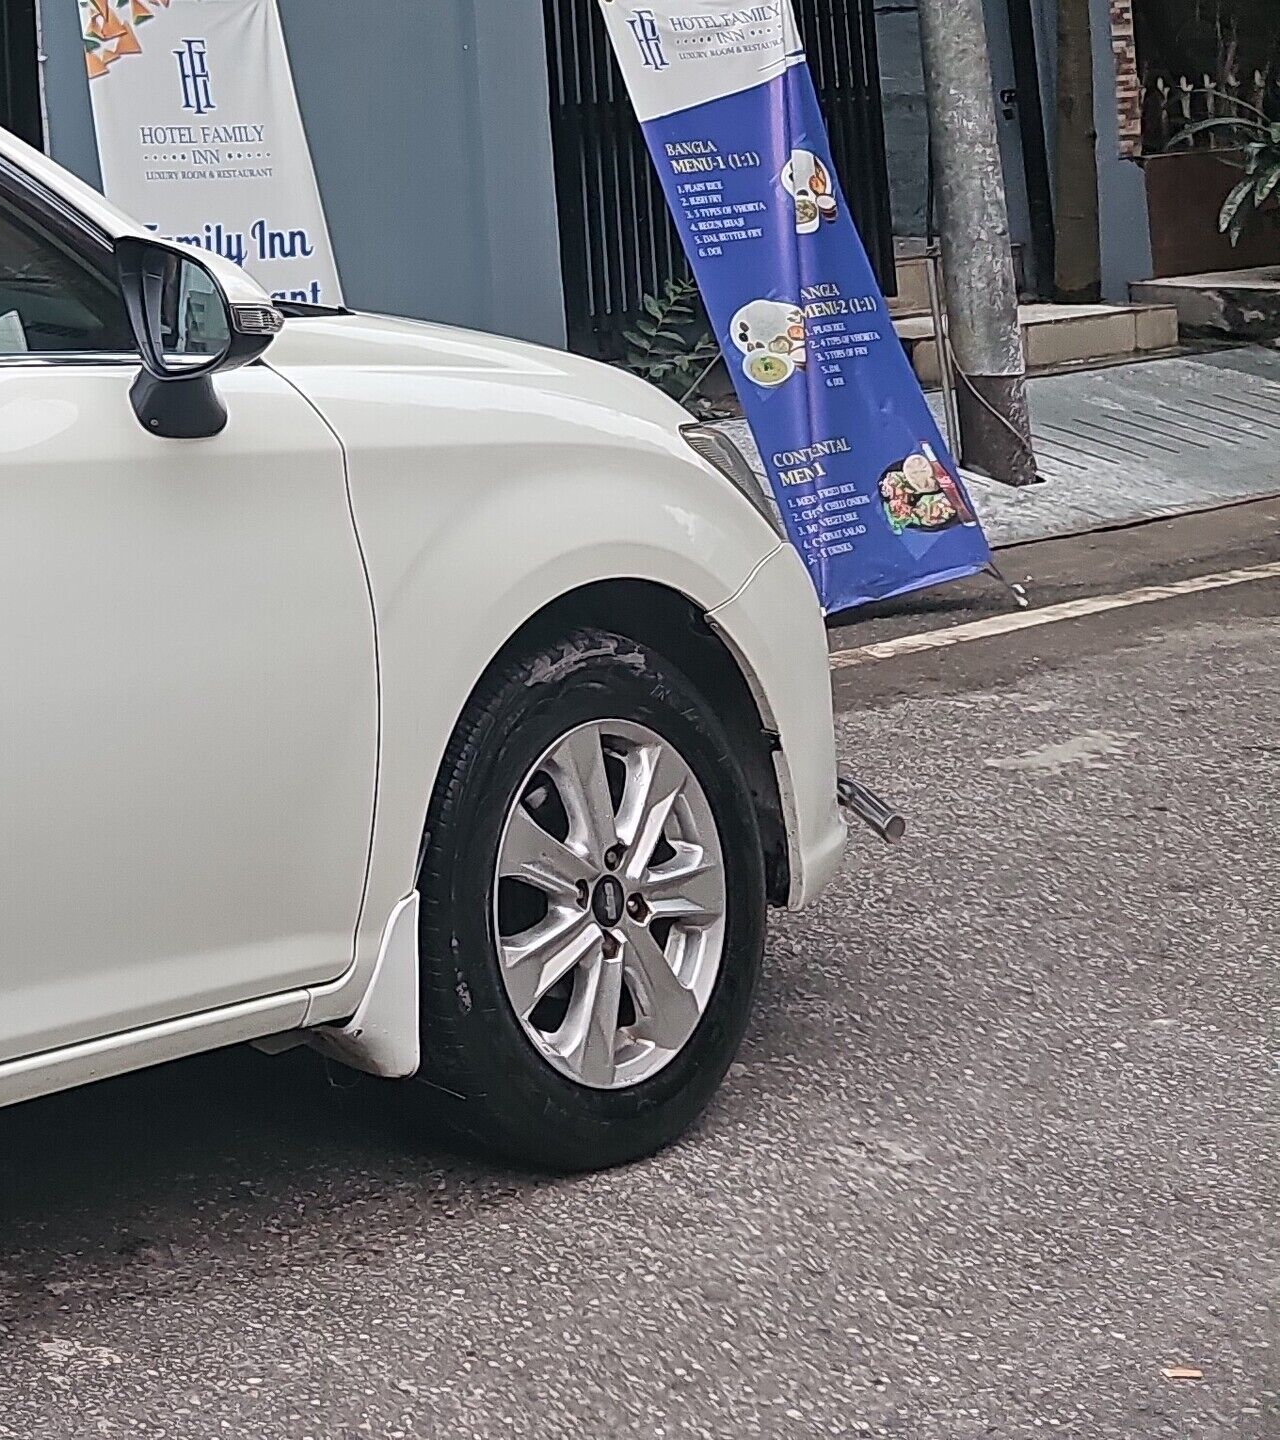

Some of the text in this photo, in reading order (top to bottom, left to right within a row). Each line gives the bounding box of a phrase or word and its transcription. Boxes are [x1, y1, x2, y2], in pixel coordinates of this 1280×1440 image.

[669, 3, 780, 31] HOTEL FAMILY
[716, 29, 746, 44] INN
[140, 124, 264, 144] HOTEL FAMILY
[191, 149, 221, 165] INN
[664, 140, 718, 157] BANGLA
[670, 151, 760, 174] MENU-1 (1:1)
[146, 170, 179, 180] LUXURY
[181, 170, 206, 180] ROOM
[216, 167, 273, 180] RESTAURANT
[251, 219, 314, 260] Inn
[801, 283, 840, 300] ANGLA
[849, 296, 877, 314] (1:1)
